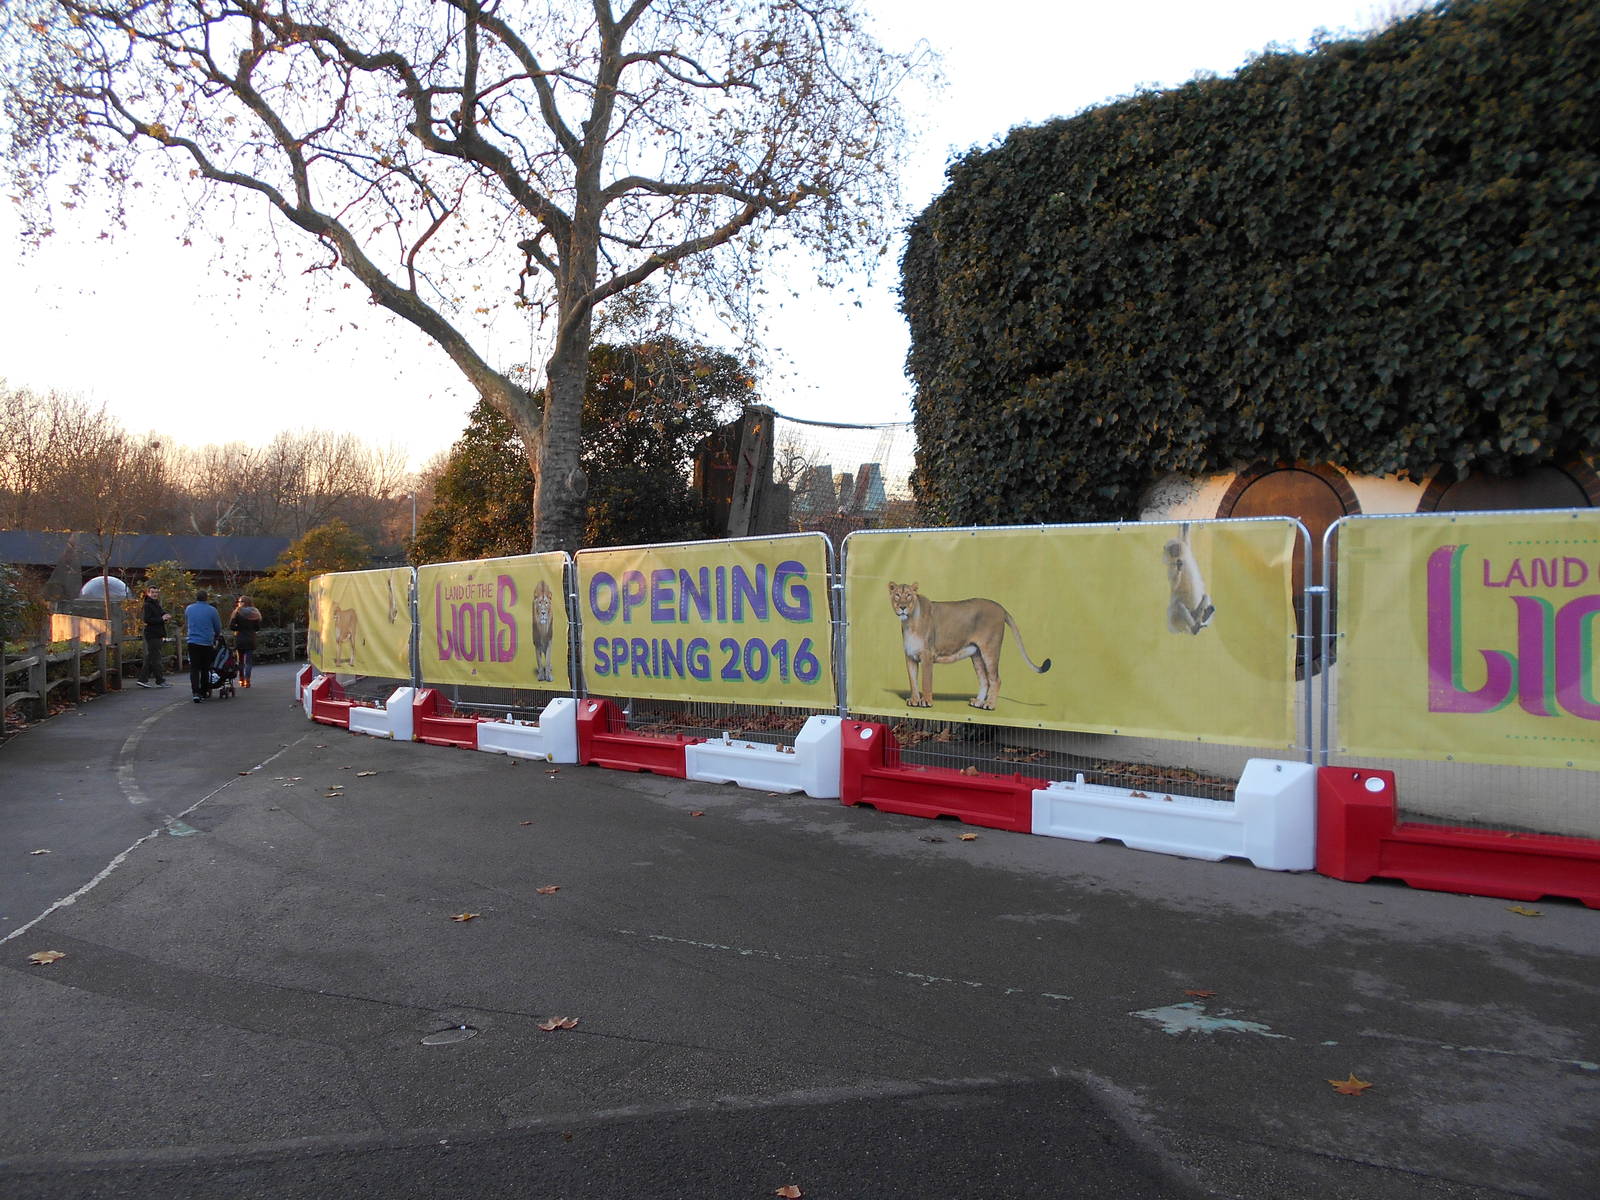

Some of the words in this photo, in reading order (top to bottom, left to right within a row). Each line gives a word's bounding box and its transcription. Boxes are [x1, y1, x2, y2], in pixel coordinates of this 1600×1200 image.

[445, 585, 464, 600] LAND
[465, 584, 476, 599] OF
[477, 583, 493, 598] THE
[590, 560, 813, 624] OPENING
[1483, 556, 1589, 588] LAND
[593, 636, 712, 681] SPRING
[719, 637, 822, 684] 2016
